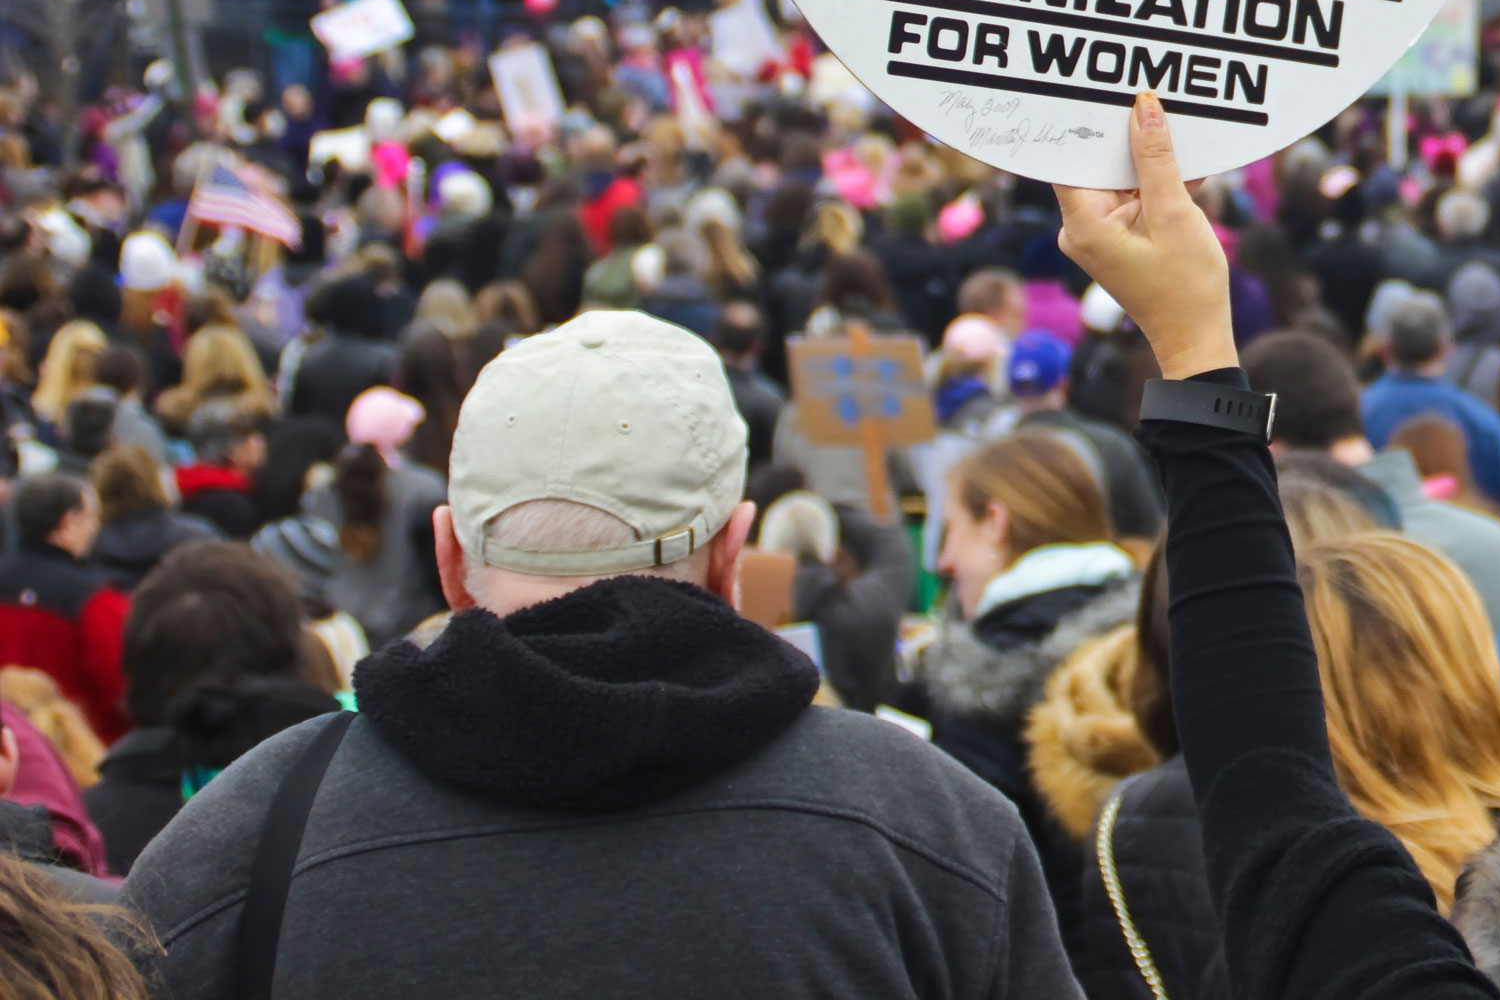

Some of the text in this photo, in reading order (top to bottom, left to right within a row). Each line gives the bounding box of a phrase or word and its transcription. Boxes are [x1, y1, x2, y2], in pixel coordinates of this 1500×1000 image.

[887, 10, 1268, 105] FOR WOMEN
[938, 90, 1021, 133] May 2009
